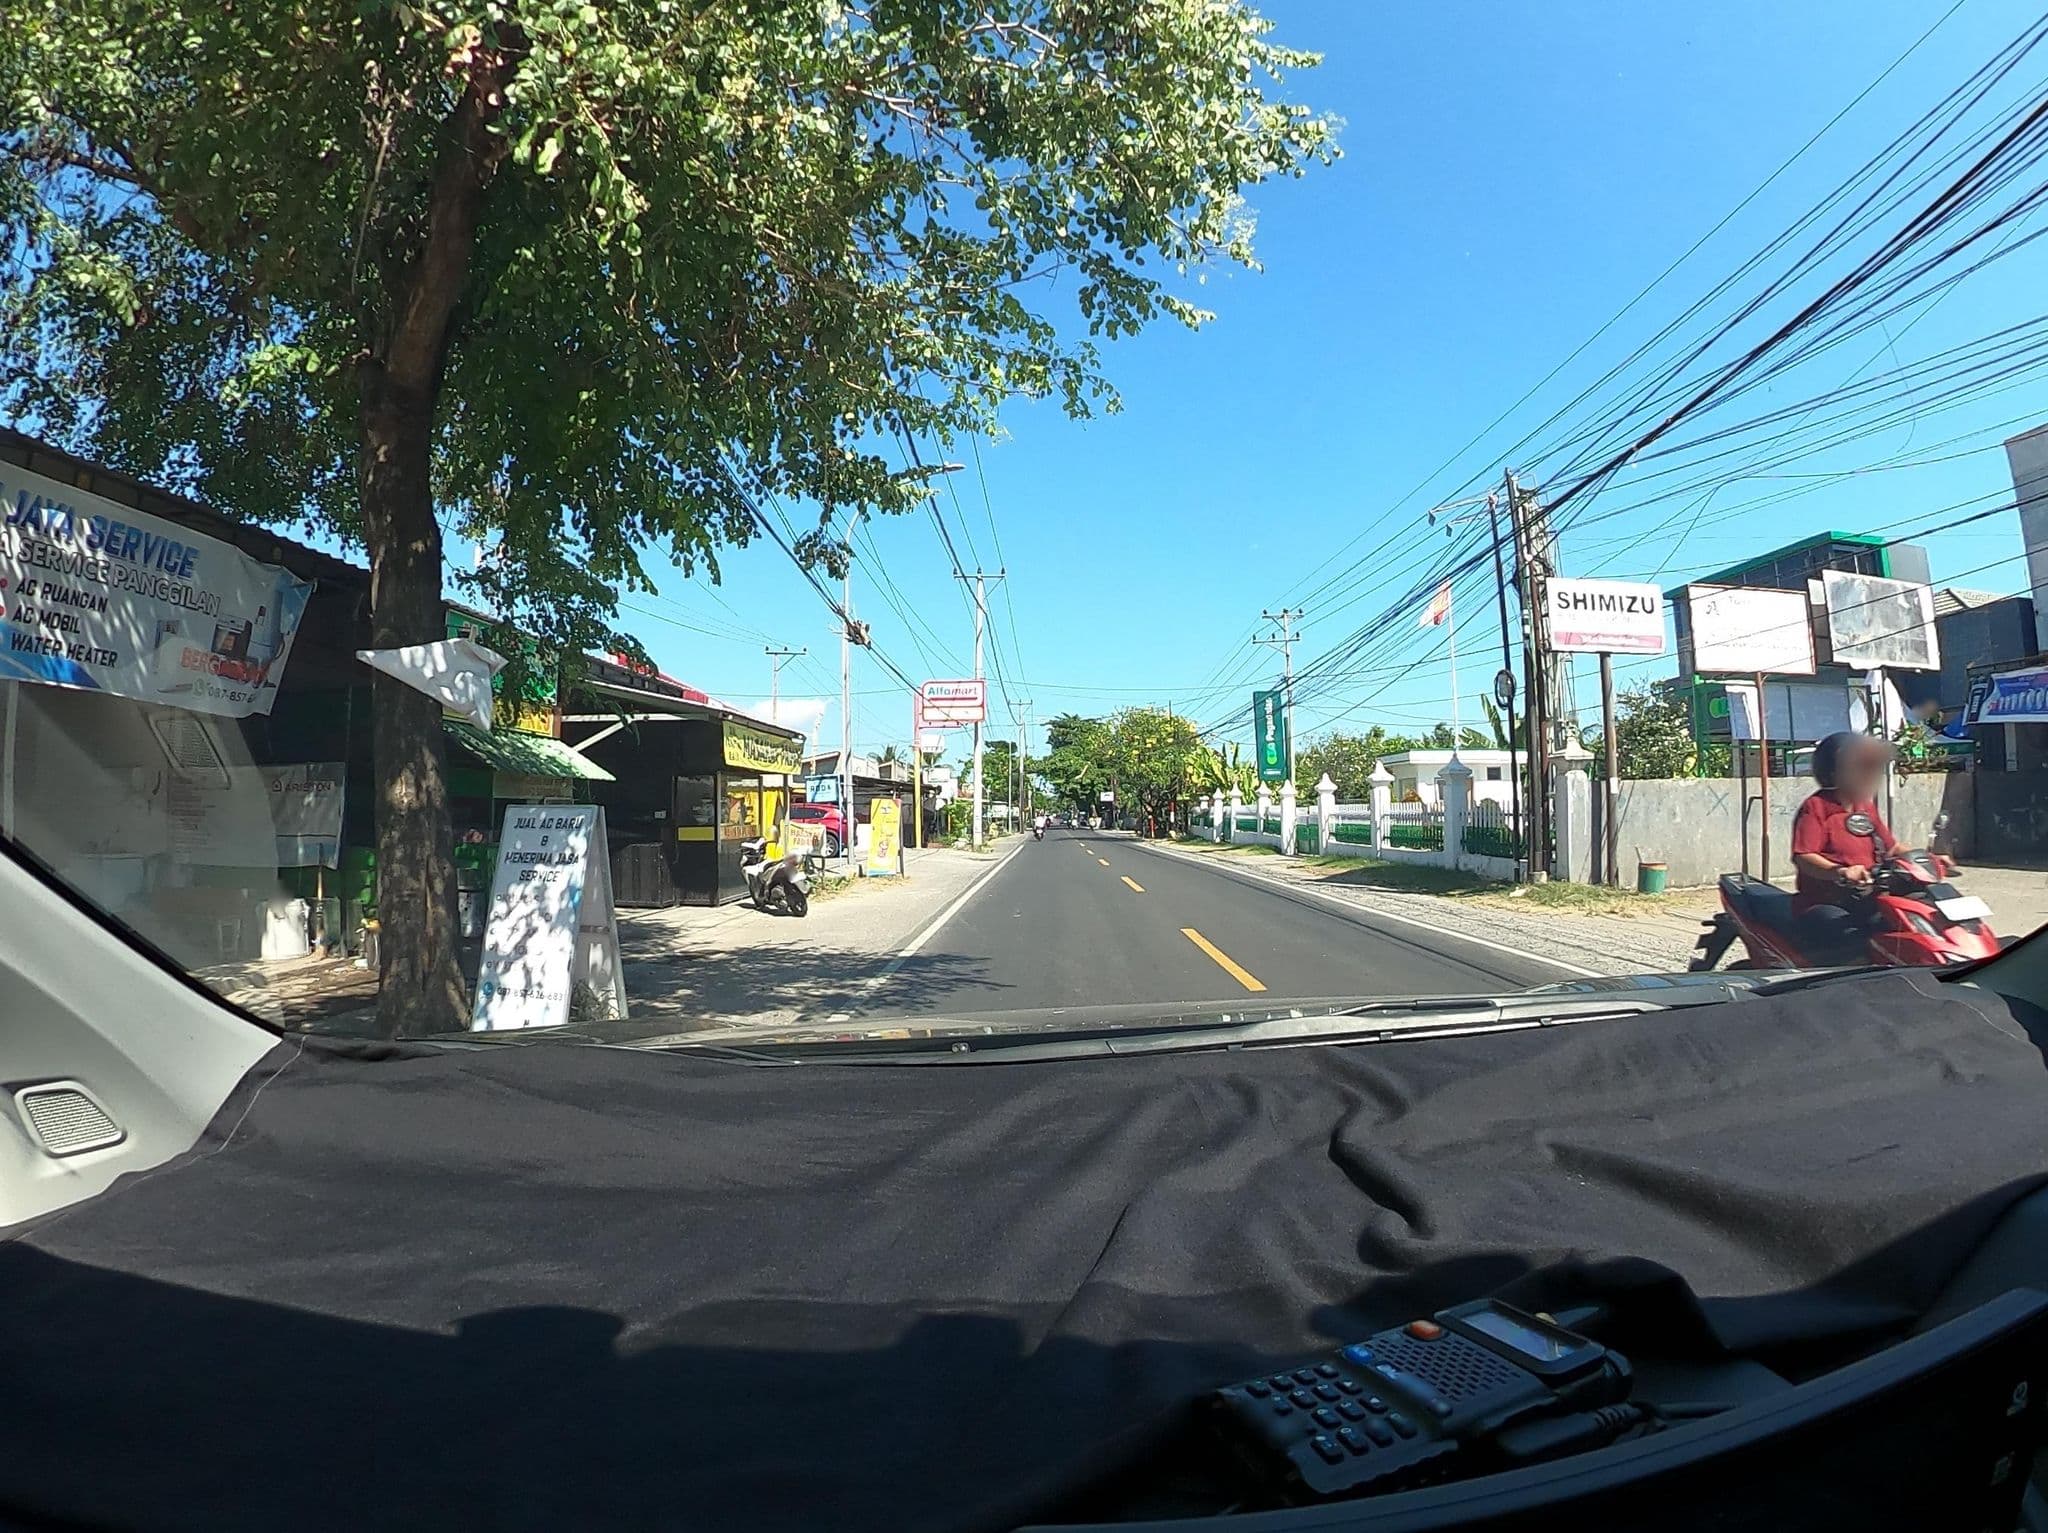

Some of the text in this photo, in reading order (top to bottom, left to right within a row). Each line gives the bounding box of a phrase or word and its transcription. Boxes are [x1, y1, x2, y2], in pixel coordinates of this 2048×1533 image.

[85, 515, 200, 578] SERVICE
[17, 537, 111, 585] SERVICE
[112, 563, 220, 618] PANGGILAN
[16, 578, 108, 613] AC RUANGAN
[1557, 591, 1654, 614] SHIMIZU
[12, 605, 80, 634] AC MOBIL
[11, 632, 118, 668] WATER HEATER
[928, 687, 977, 696] Alfamart
[514, 817, 584, 830] JUAL AC BARU
[504, 851, 579, 865] MENERIMA JASA
[519, 870, 560, 882] SERVICE
